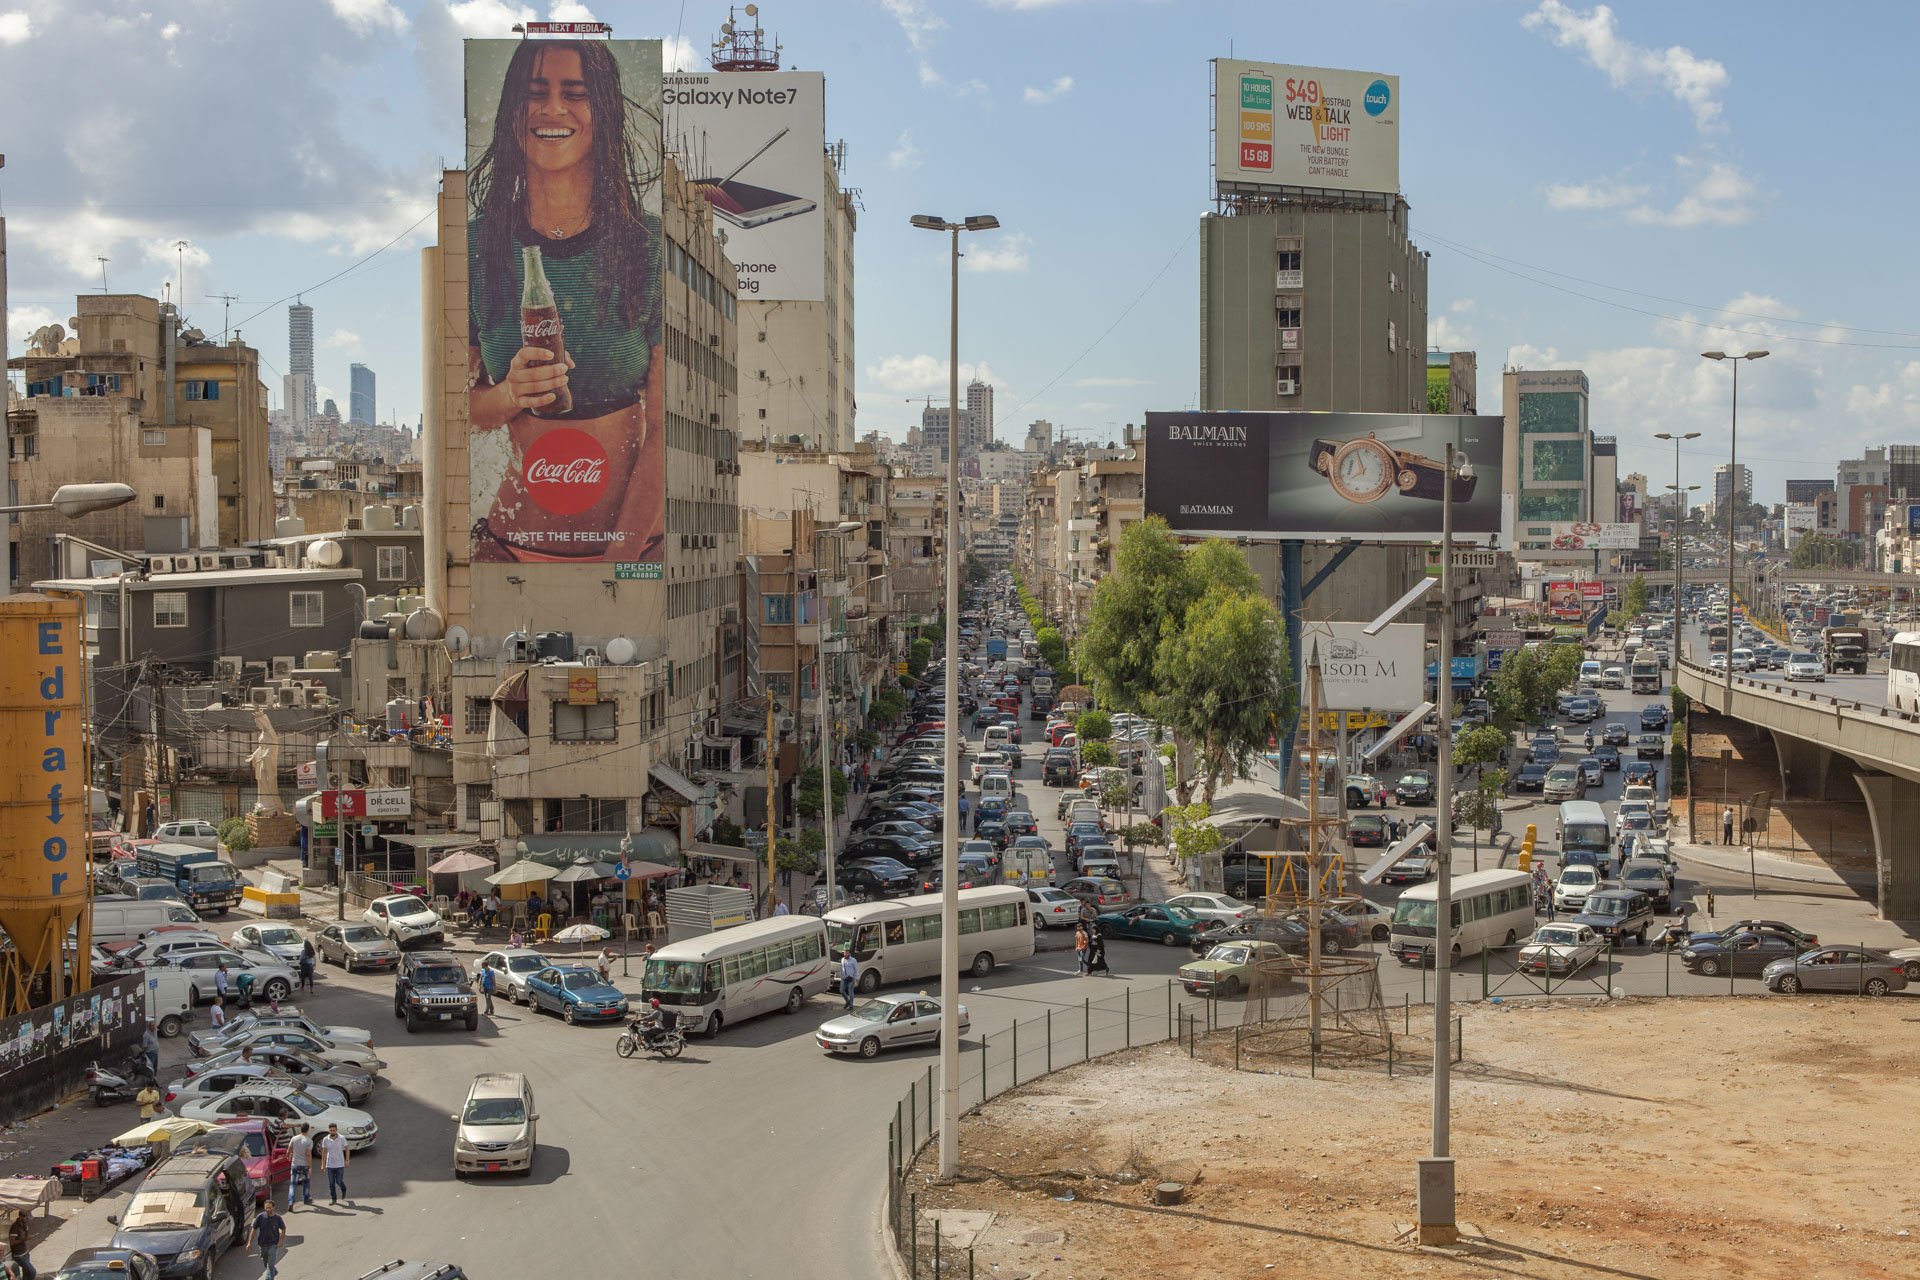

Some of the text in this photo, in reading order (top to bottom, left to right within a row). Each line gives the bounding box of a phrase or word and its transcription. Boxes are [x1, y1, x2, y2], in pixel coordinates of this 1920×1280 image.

[549, 24, 570, 32] NEXT
[663, 76, 709, 85] SAMSUNG
[1243, 82, 1270, 94] 10 HOURS
[1286, 78, 1318, 103] $49
[662, 88, 797, 109] Galaxy Note7
[1243, 94, 1270, 105] talk time
[1322, 96, 1351, 108] POSTPAID
[1366, 92, 1387, 105] touch
[1286, 104, 1350, 124] WEB & TALK
[1243, 121, 1270, 132] 100 SMS
[1320, 126, 1350, 142] LIGHT
[1244, 148, 1269, 162] 1.5 GB
[1300, 144, 1349, 156] THE NEW BUNDLE
[1308, 155, 1349, 167] YOUR BATTERY
[1308, 166, 1349, 178] CAN'T HANDLE
[738, 277, 760, 294] big
[1168, 426, 1248, 441] BALMAIN
[527, 458, 606, 484] Coca-Cola
[1190, 505, 1234, 514] ATAMIAN
[506, 532, 625, 542] TASTE THE FEELING
[1462, 554, 1494, 566] 611115
[1375, 660, 1397, 678] M
